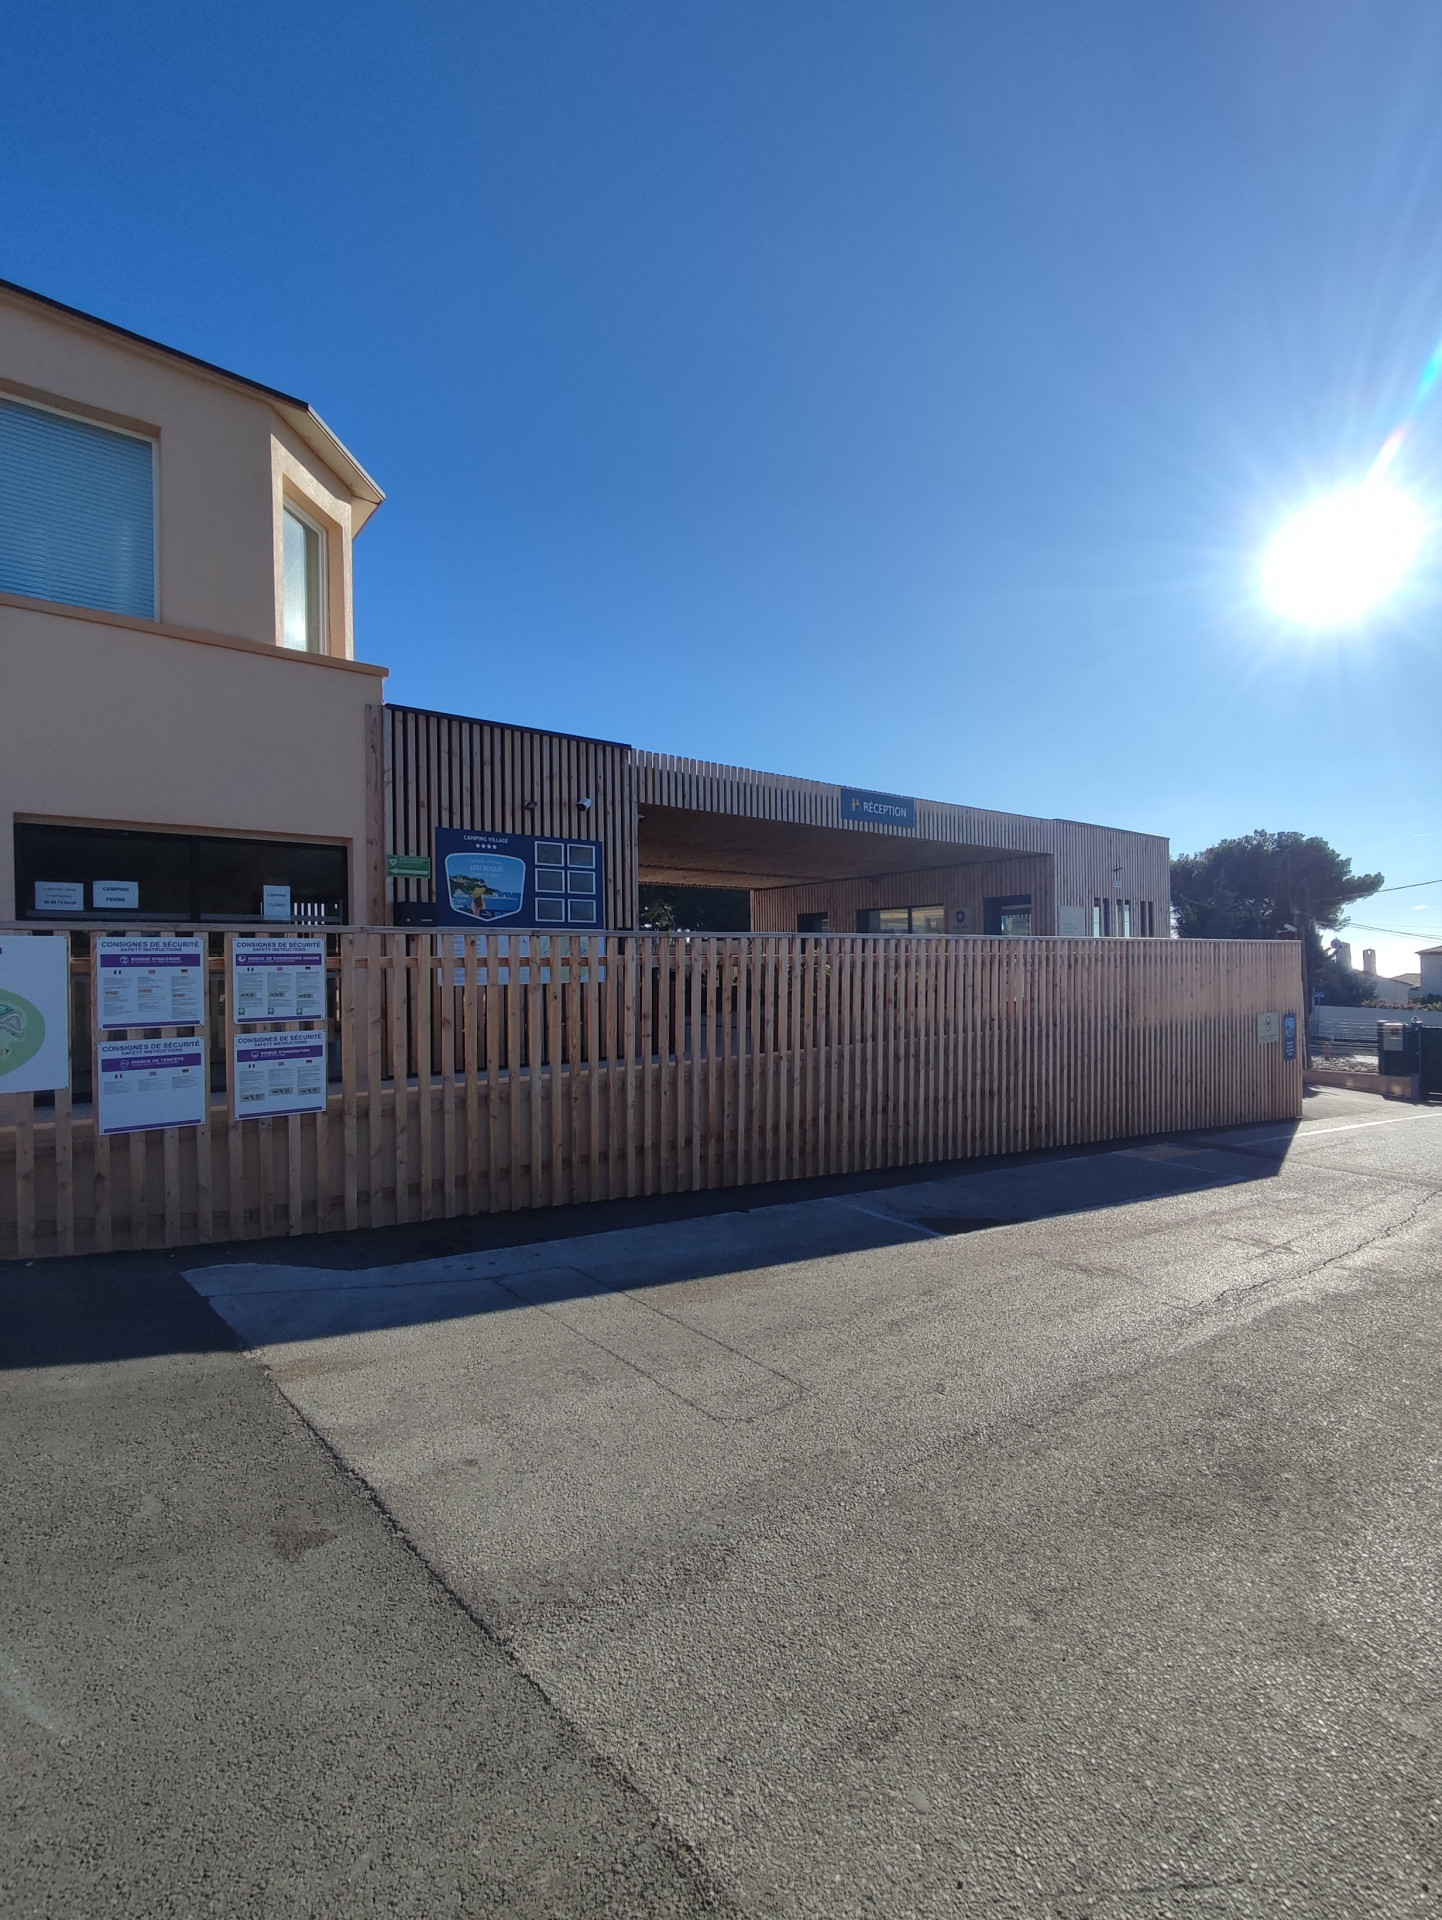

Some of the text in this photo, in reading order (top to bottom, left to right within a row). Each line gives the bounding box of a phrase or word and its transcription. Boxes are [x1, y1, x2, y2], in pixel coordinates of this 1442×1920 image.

[863, 801, 907, 818] RÉCEPTION
[464, 834, 488, 842] CAMPING
[238, 1036, 278, 1044] CONSIGNES
[102, 1043, 149, 1052] CONSIGNES
